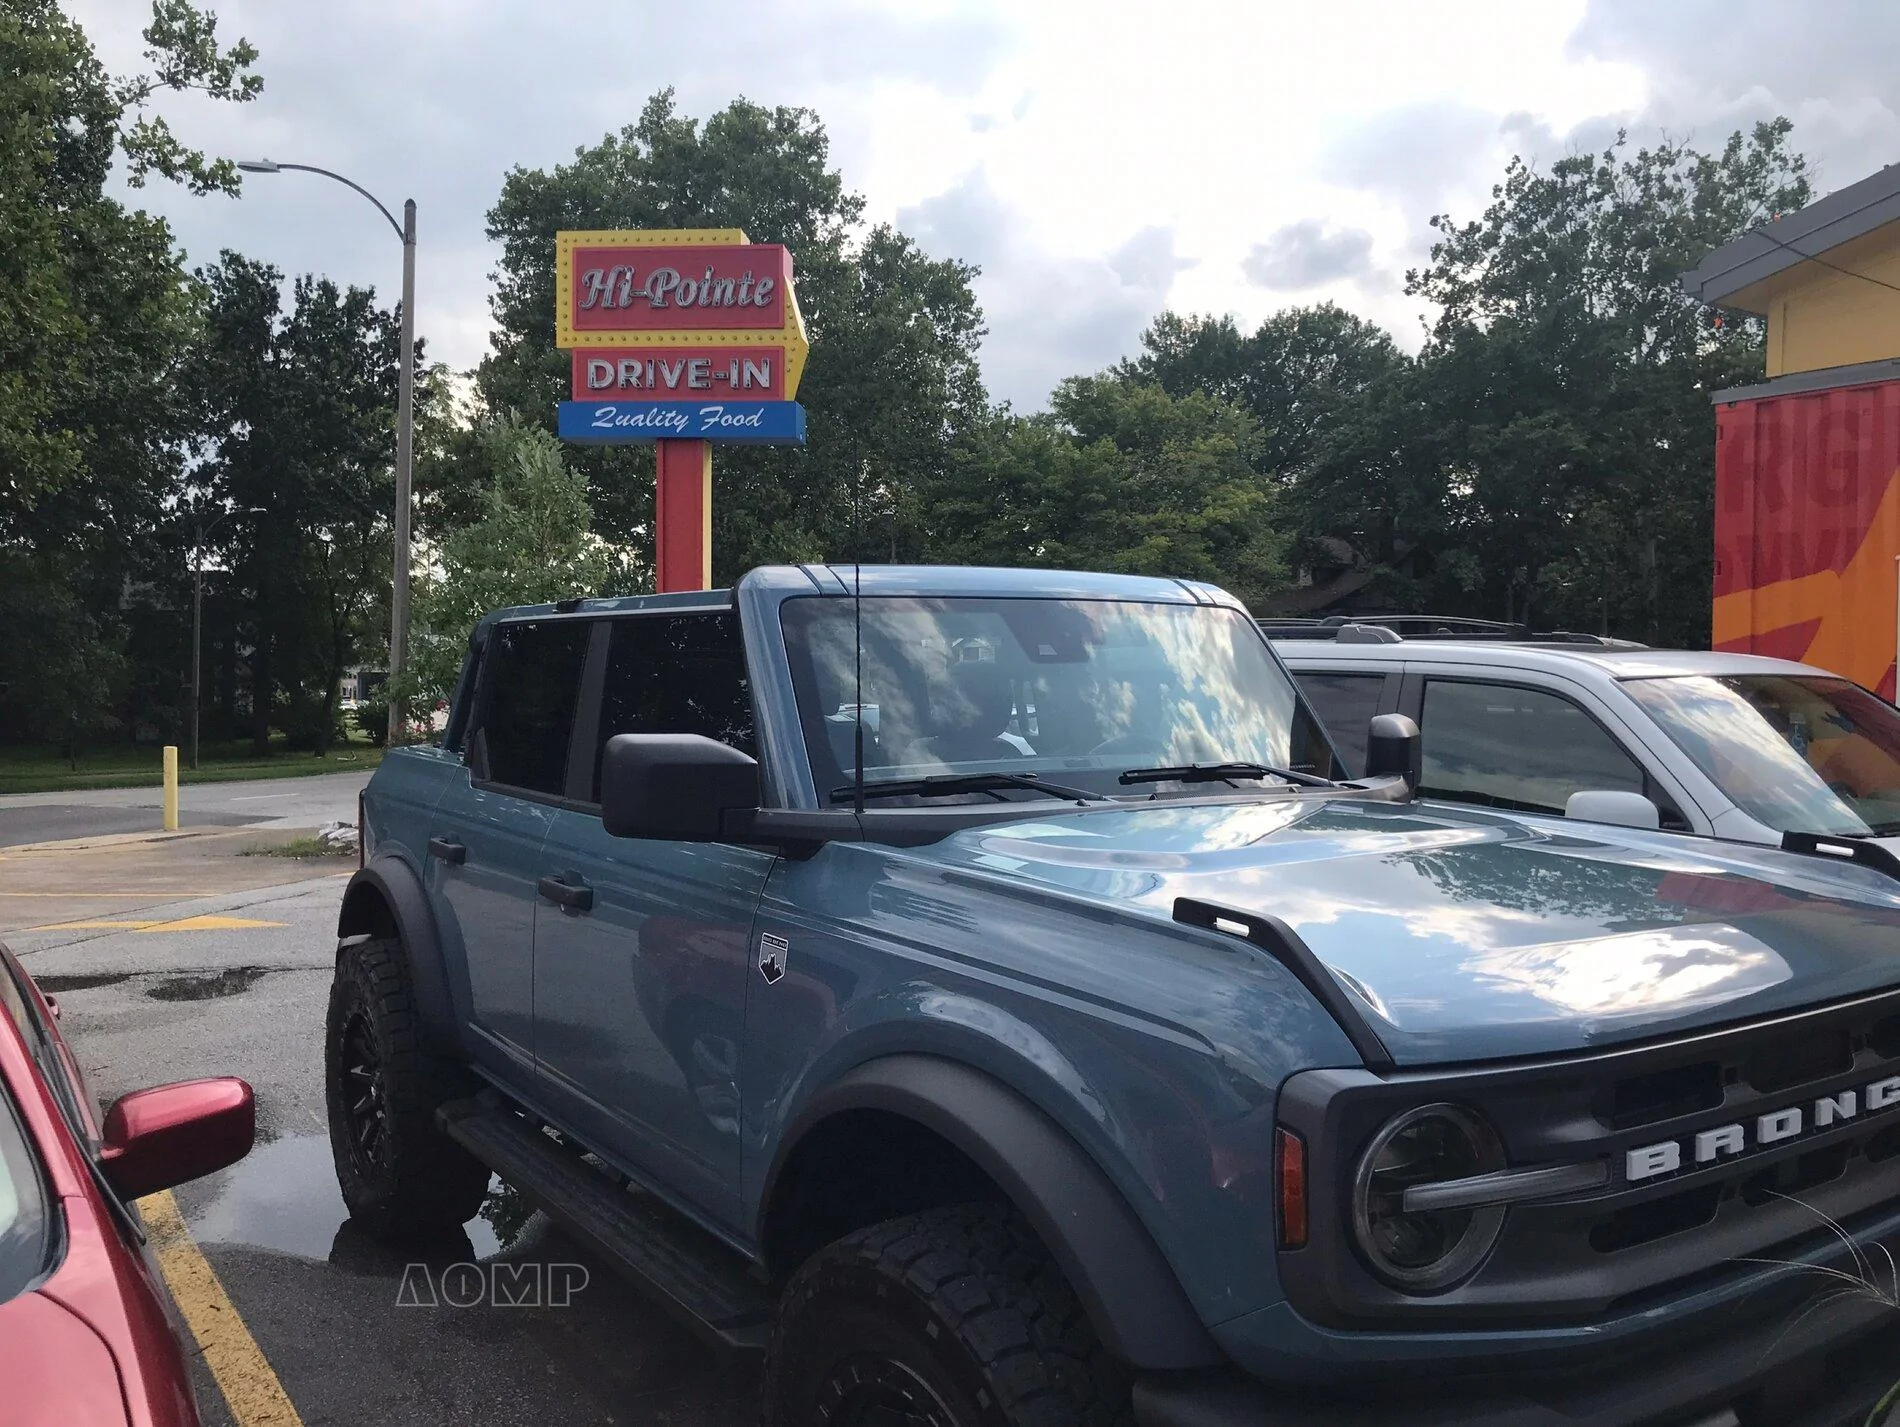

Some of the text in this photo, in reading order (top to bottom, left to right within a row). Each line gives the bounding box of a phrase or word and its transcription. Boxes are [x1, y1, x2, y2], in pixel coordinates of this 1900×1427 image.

[578, 264, 774, 310] Hi-Pointe
[586, 357, 772, 390] DRIVE-IN
[591, 405, 765, 433] Quality Food
